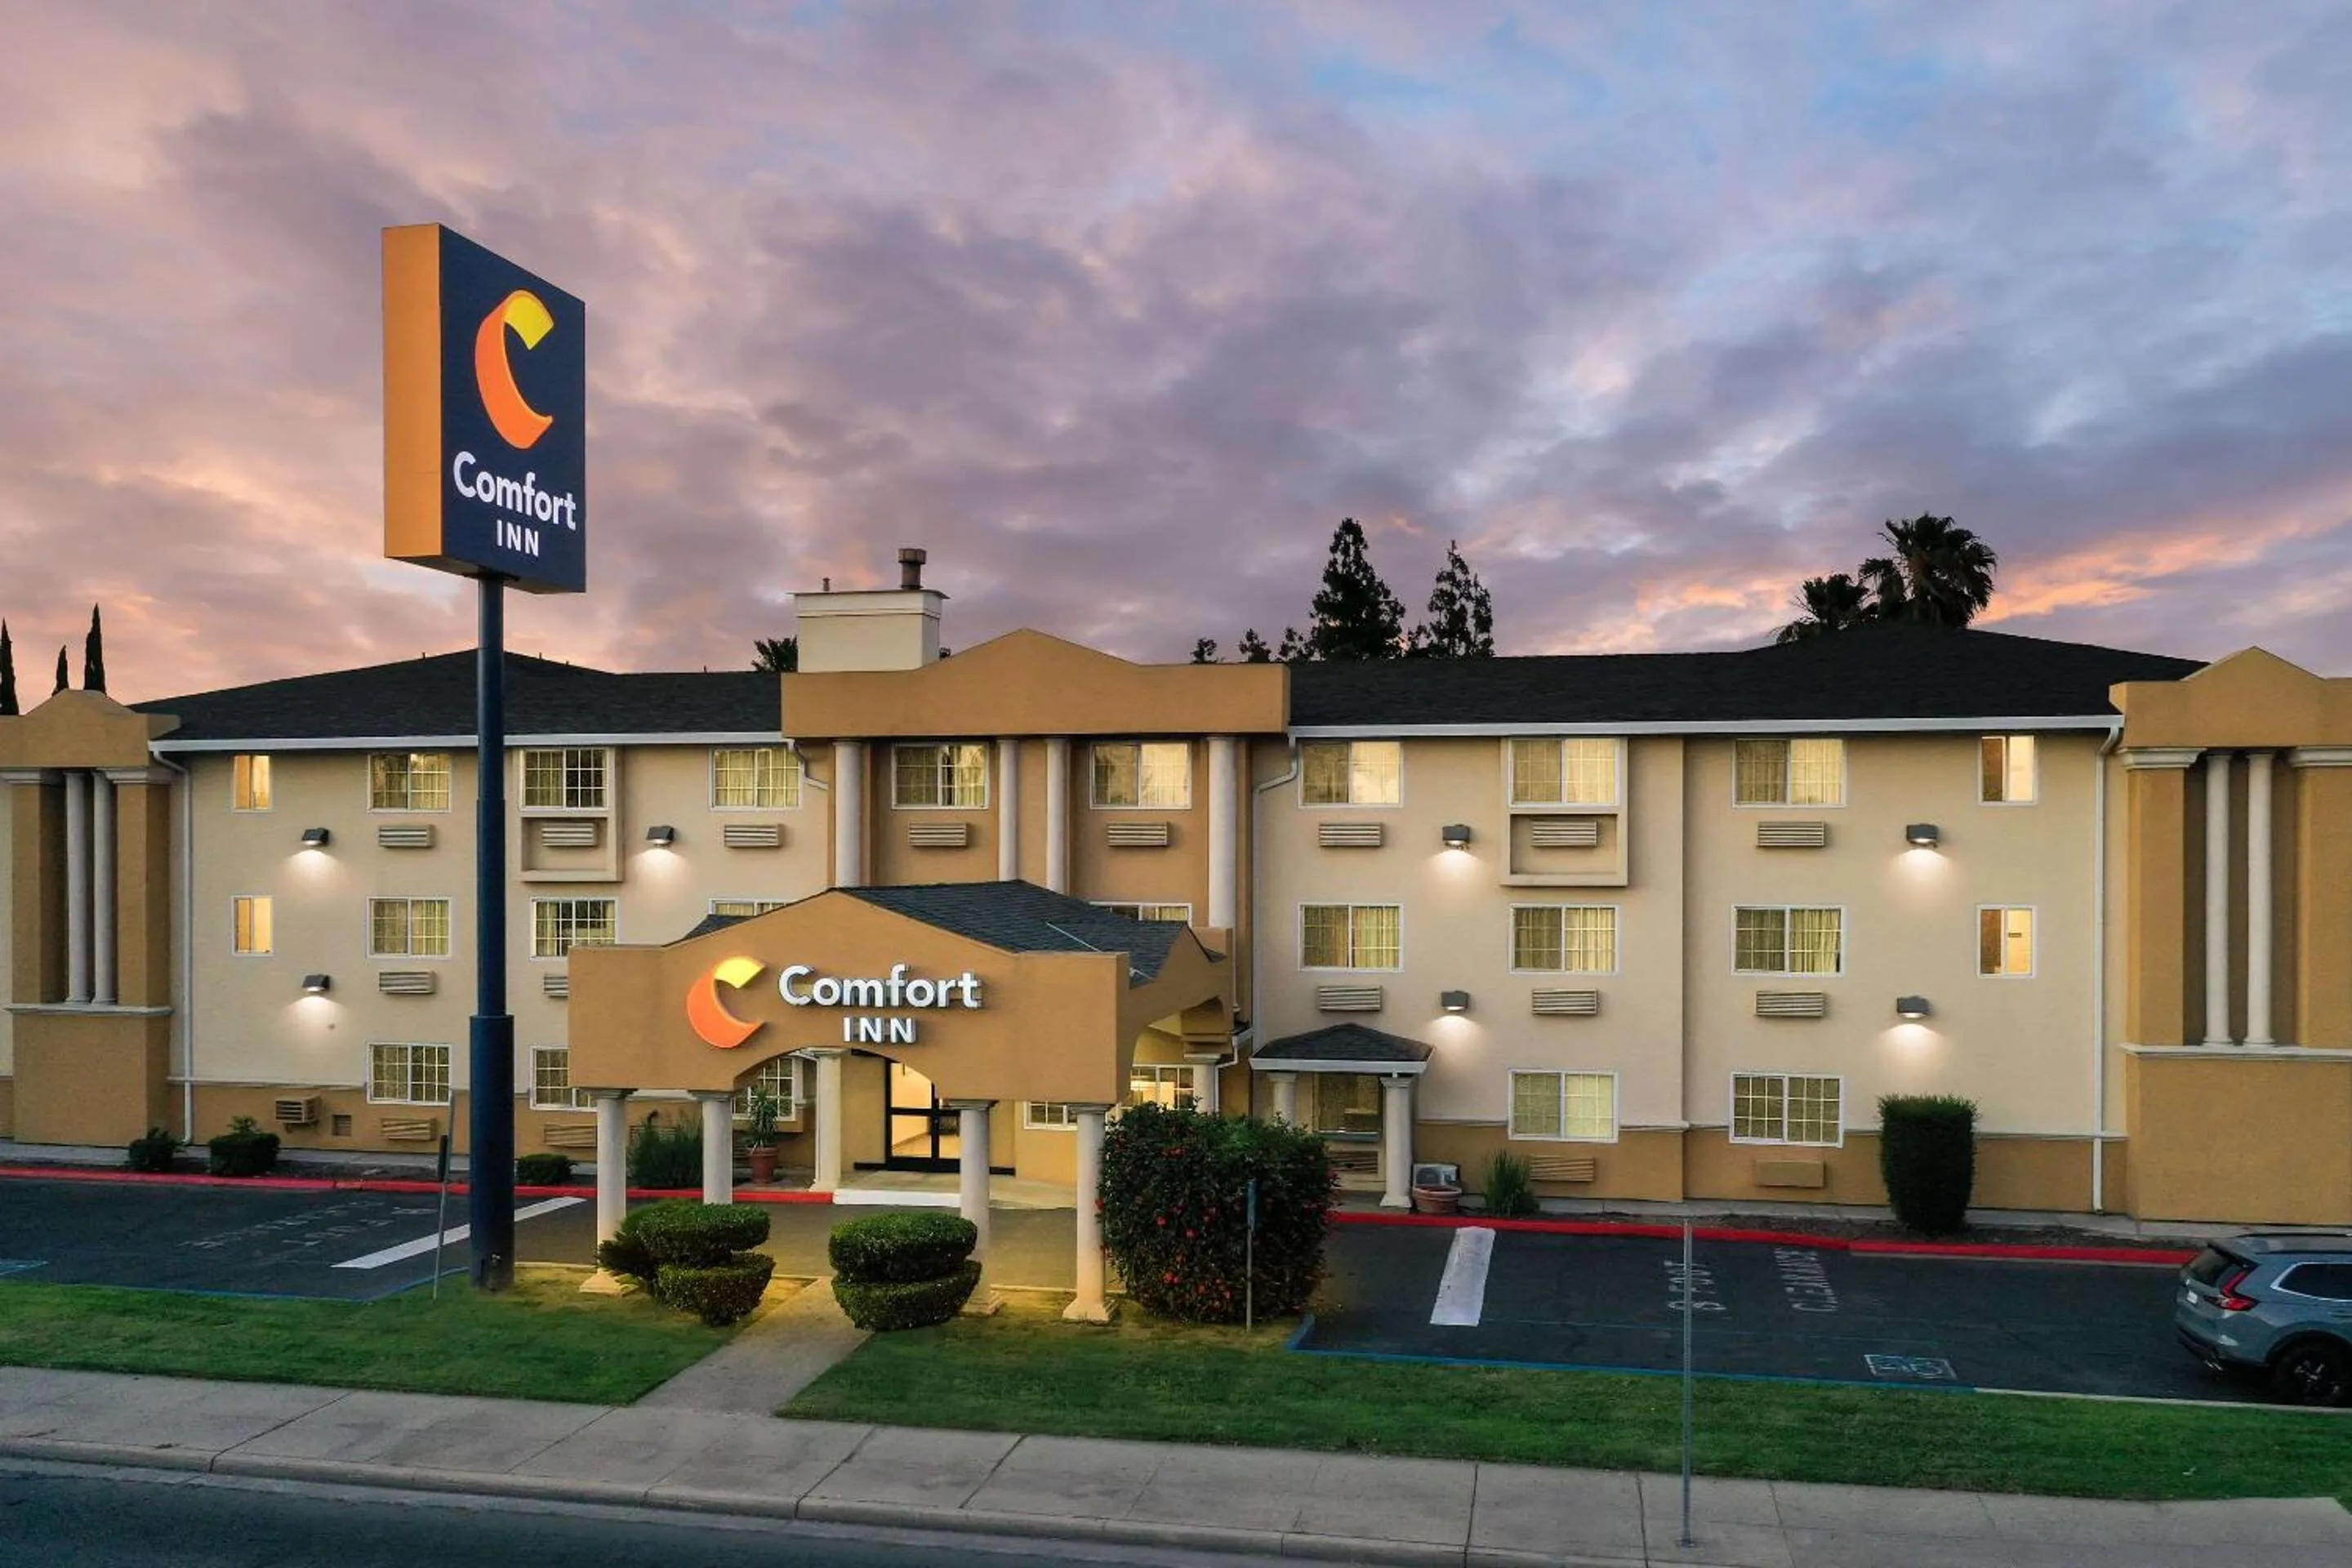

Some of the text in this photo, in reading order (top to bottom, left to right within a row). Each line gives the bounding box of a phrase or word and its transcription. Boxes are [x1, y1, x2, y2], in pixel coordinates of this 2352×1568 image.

[453, 451, 577, 530] Comfort
[497, 519, 539, 557] INN
[778, 964, 980, 1008] Comfort
[843, 1017, 915, 1043] INN
